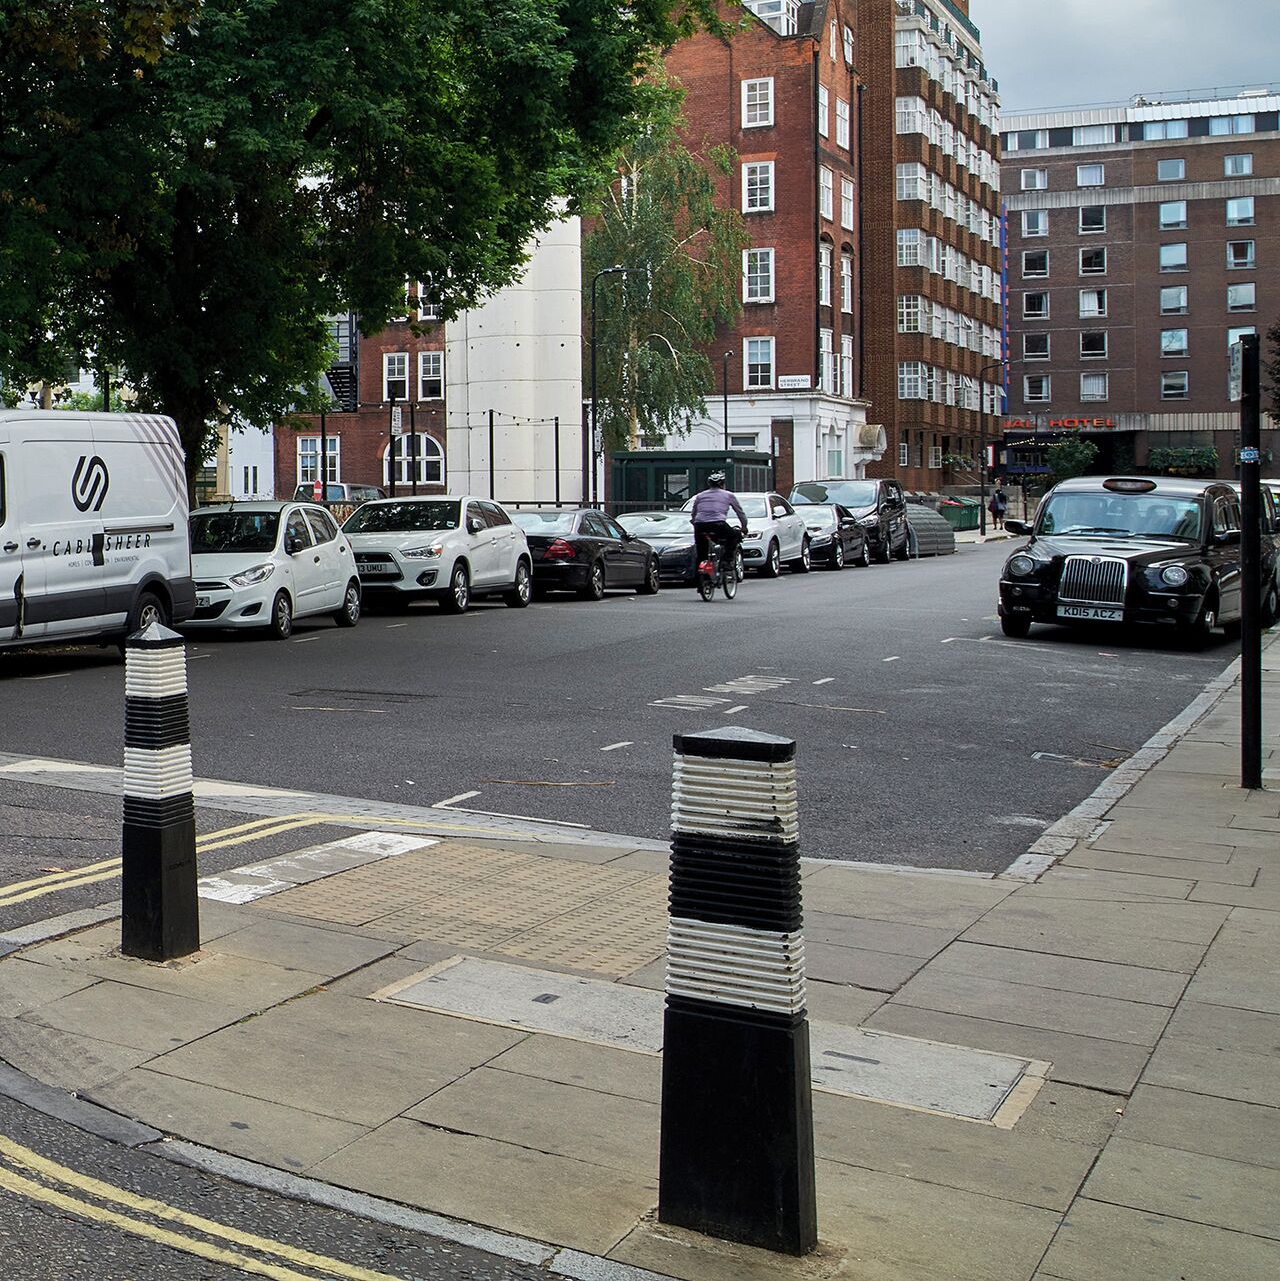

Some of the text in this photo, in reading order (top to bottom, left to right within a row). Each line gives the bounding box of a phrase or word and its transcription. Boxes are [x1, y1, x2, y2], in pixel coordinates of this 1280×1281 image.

[1049, 418, 1117, 428] HOTEL
[52, 533, 152, 557] CABLSHEER
[1063, 607, 1116, 619] KD15 ACZ
